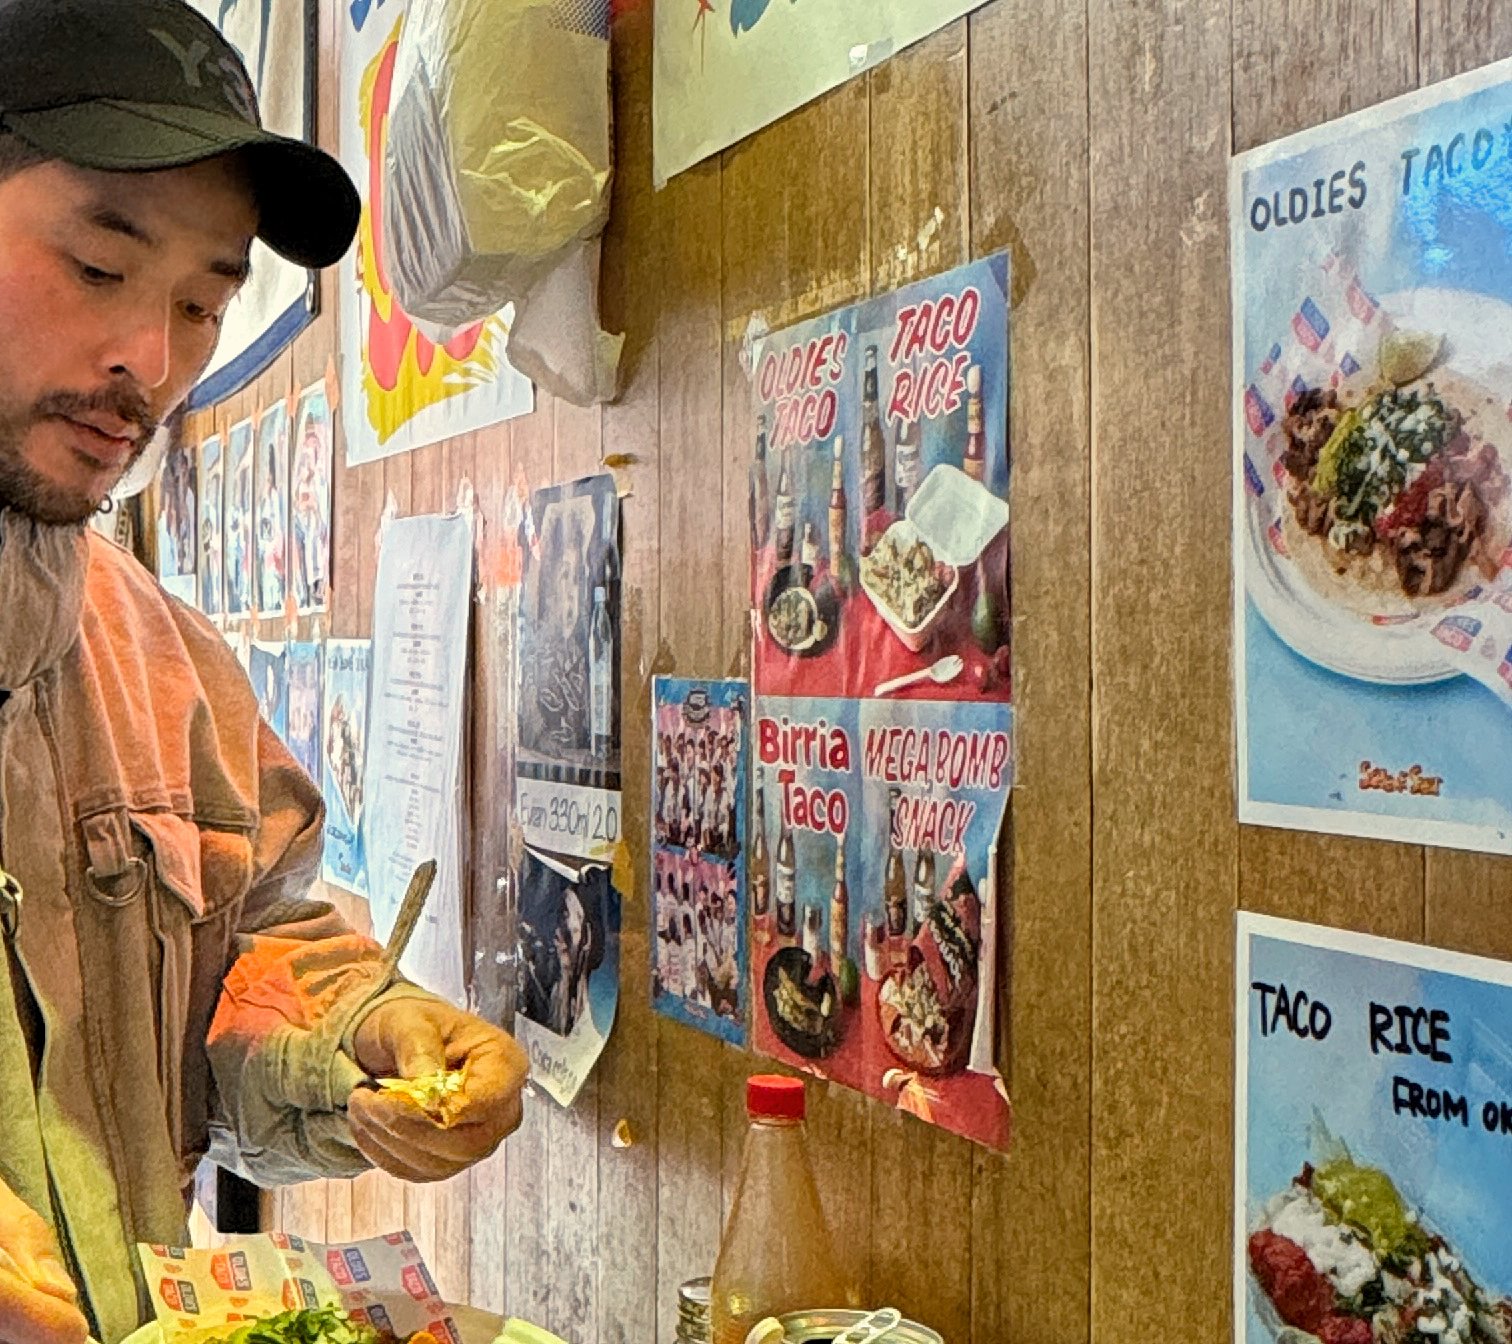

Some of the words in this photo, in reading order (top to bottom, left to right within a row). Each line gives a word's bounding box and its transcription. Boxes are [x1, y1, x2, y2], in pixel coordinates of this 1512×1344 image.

[1249, 160, 1368, 233] OLDIES
[888, 285, 982, 364] TACO
[759, 330, 849, 402] OLDIES
[887, 350, 971, 426] RICE
[767, 388, 840, 452] TACO
[757, 717, 852, 775] Birria
[864, 726, 931, 786] MEGA
[934, 728, 1009, 792] BOMB
[776, 768, 849, 836] Taco
[891, 794, 976, 856] SNACK
[1250, 982, 1332, 1042] TACO
[1369, 999, 1453, 1065] RICE
[1392, 1075, 1470, 1128] FROM
